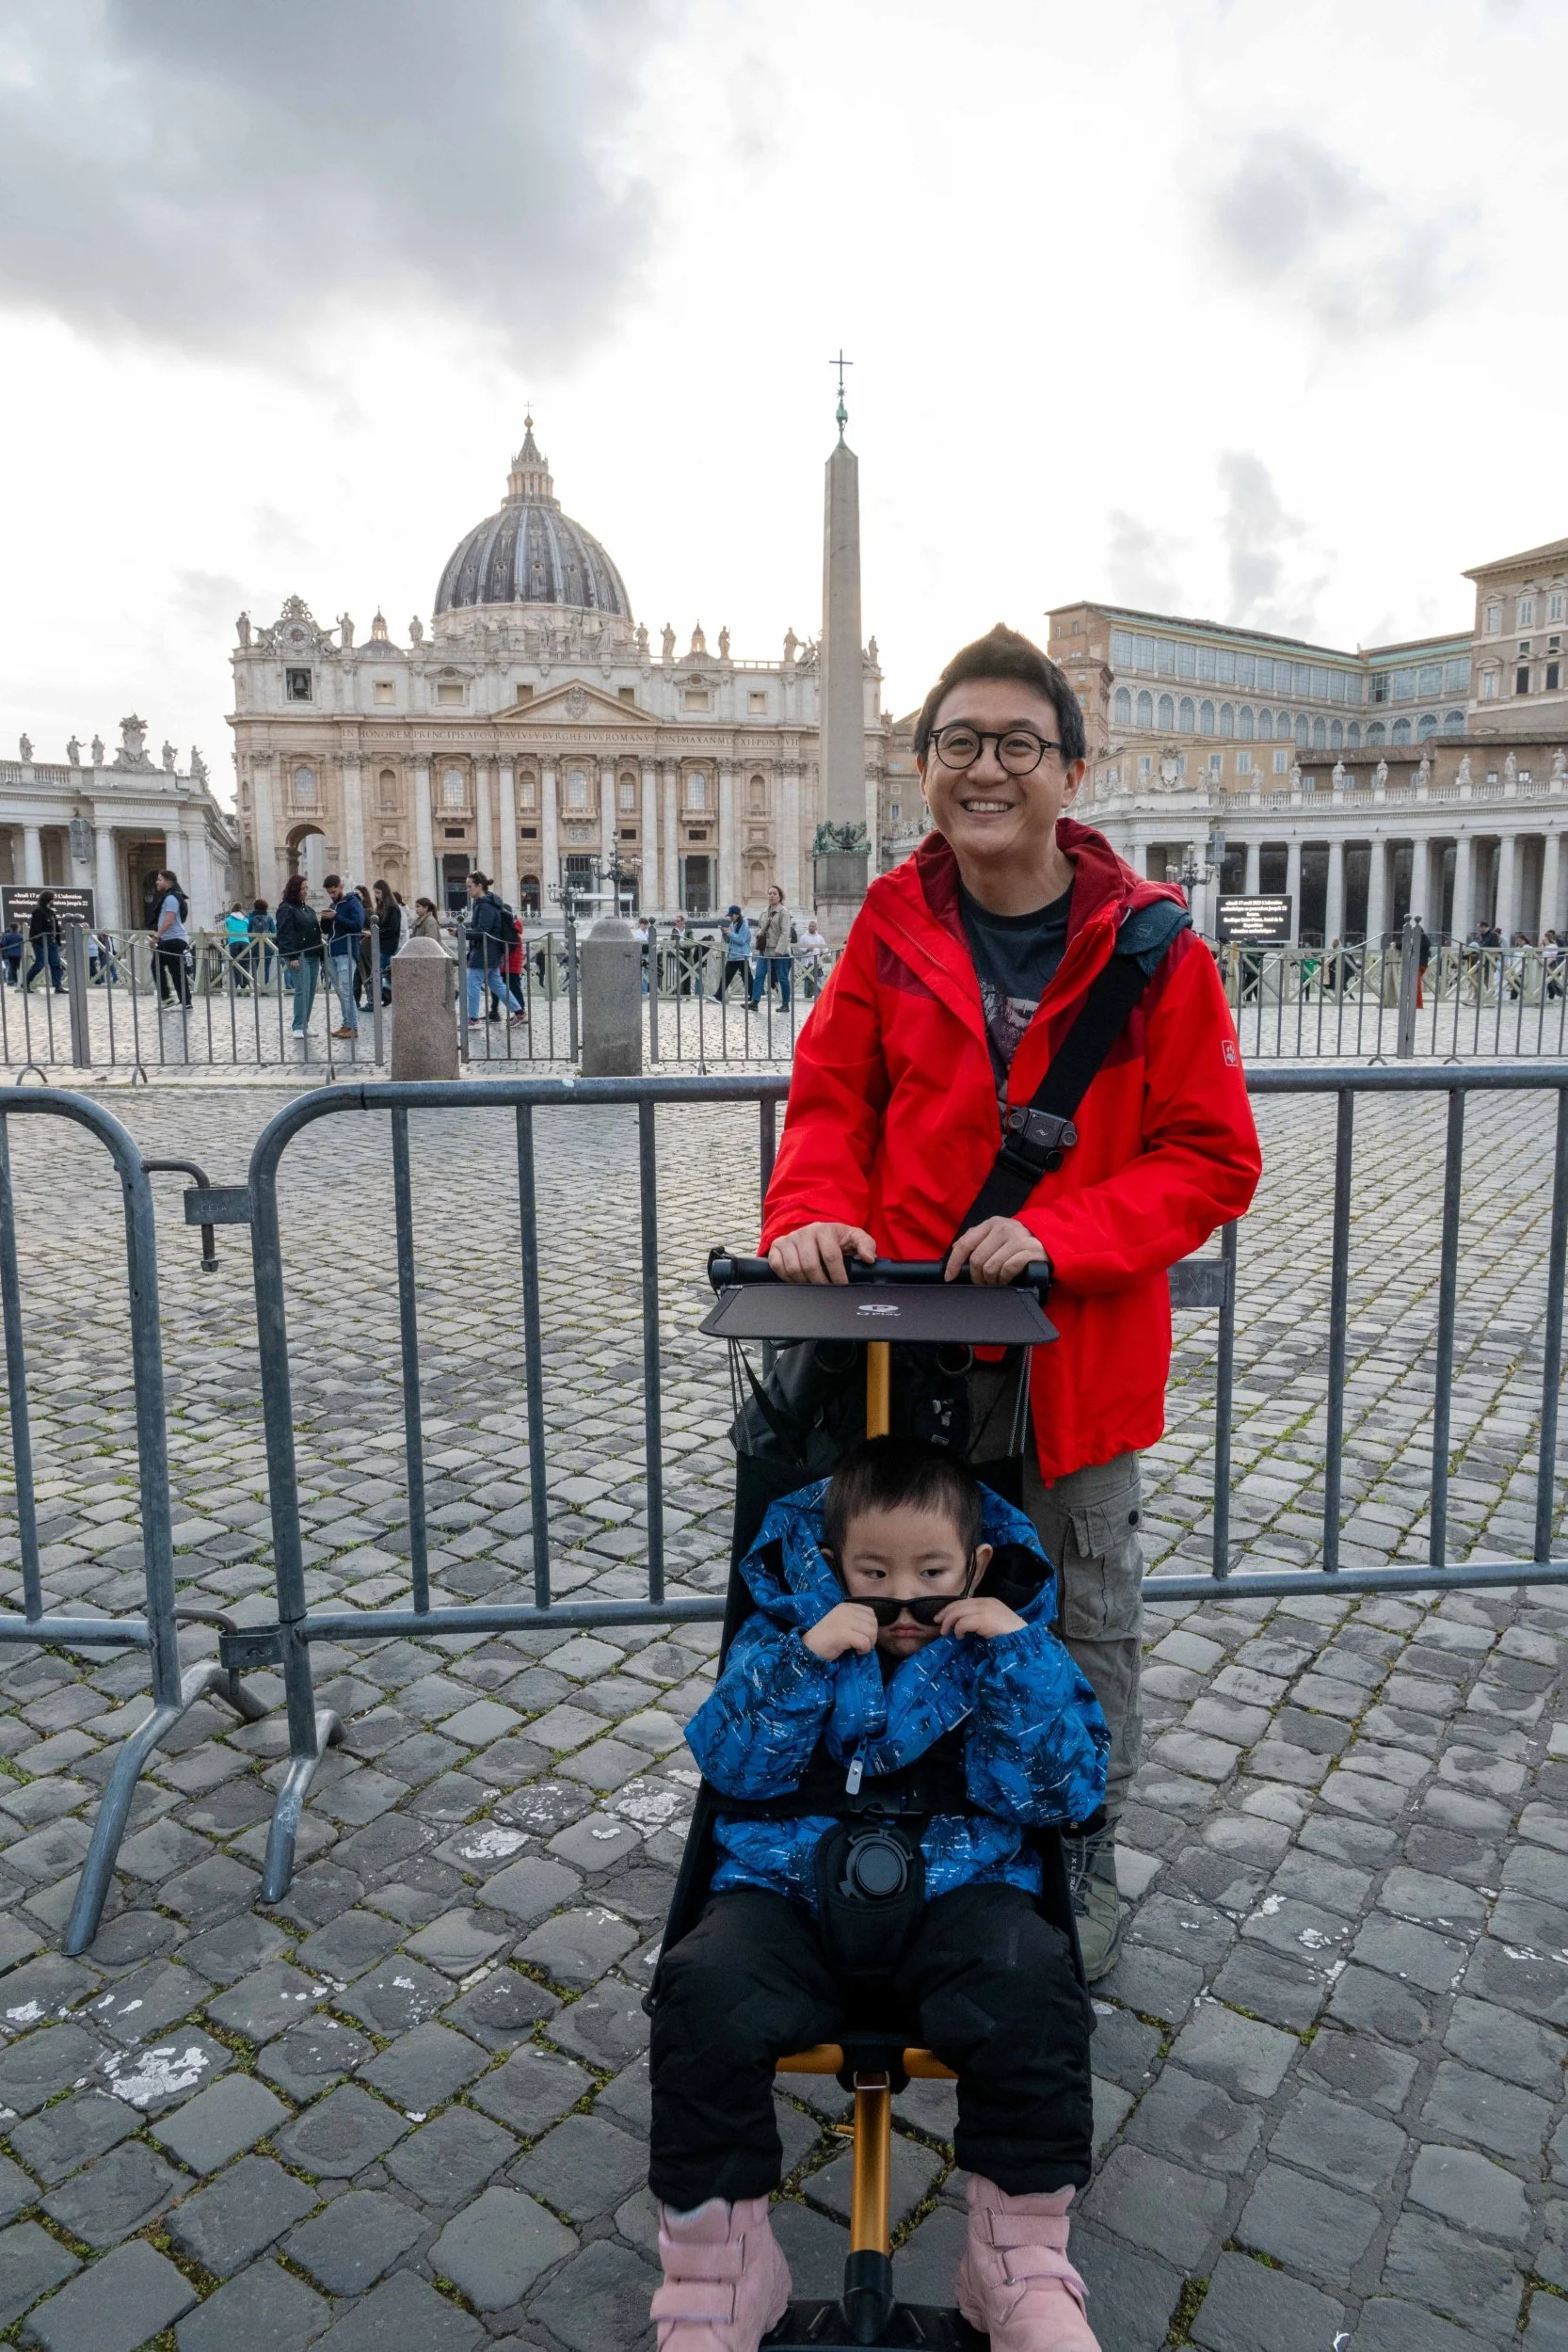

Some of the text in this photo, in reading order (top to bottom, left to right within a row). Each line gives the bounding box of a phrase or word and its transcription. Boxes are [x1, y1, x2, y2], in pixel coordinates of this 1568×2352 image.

[342, 728, 354, 737] IN
[360, 729, 411, 739] HONOREM
[413, 729, 465, 740] PRINCIPIS
[468, 730, 498, 740] APOST
[499, 730, 533, 740] PAVLVS
[542, 731, 603, 741] BVRGHESIVS
[605, 732, 656, 742] ROMANVS
